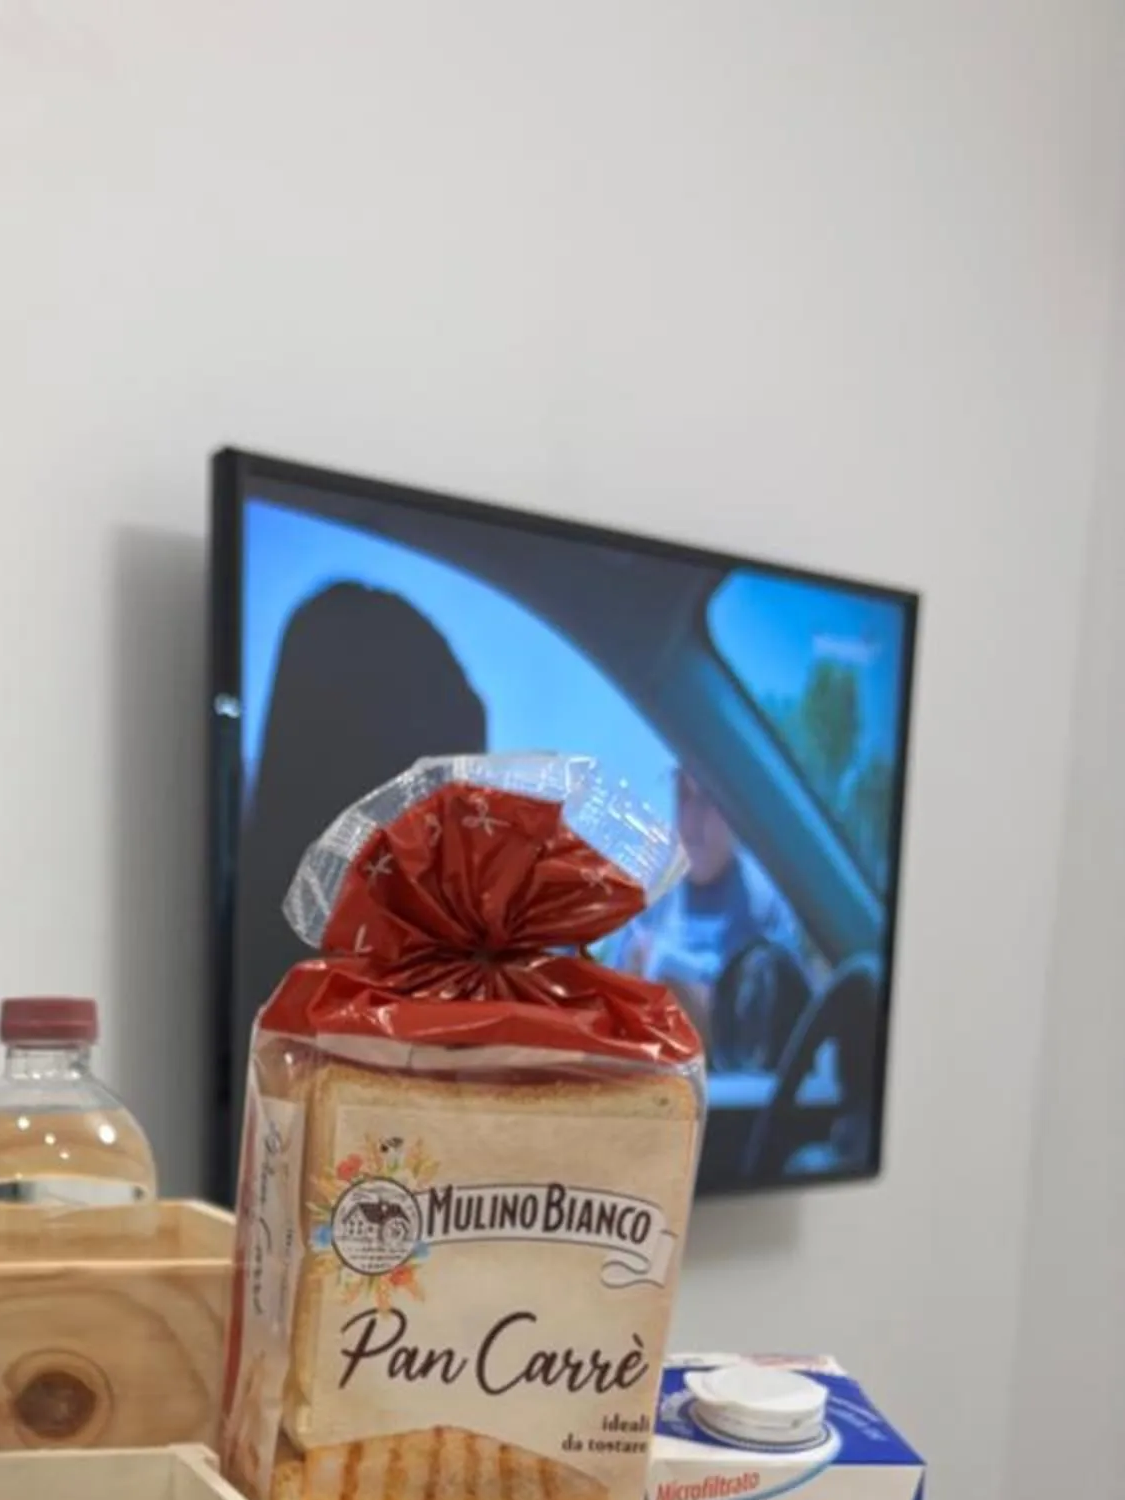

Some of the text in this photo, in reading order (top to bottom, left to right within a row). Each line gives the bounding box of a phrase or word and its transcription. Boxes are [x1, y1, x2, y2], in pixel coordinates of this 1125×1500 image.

[339, 1308, 649, 1396] Pan Carrè
[601, 1413, 651, 1434] ideali
[561, 1435, 649, 1456] da tostare
